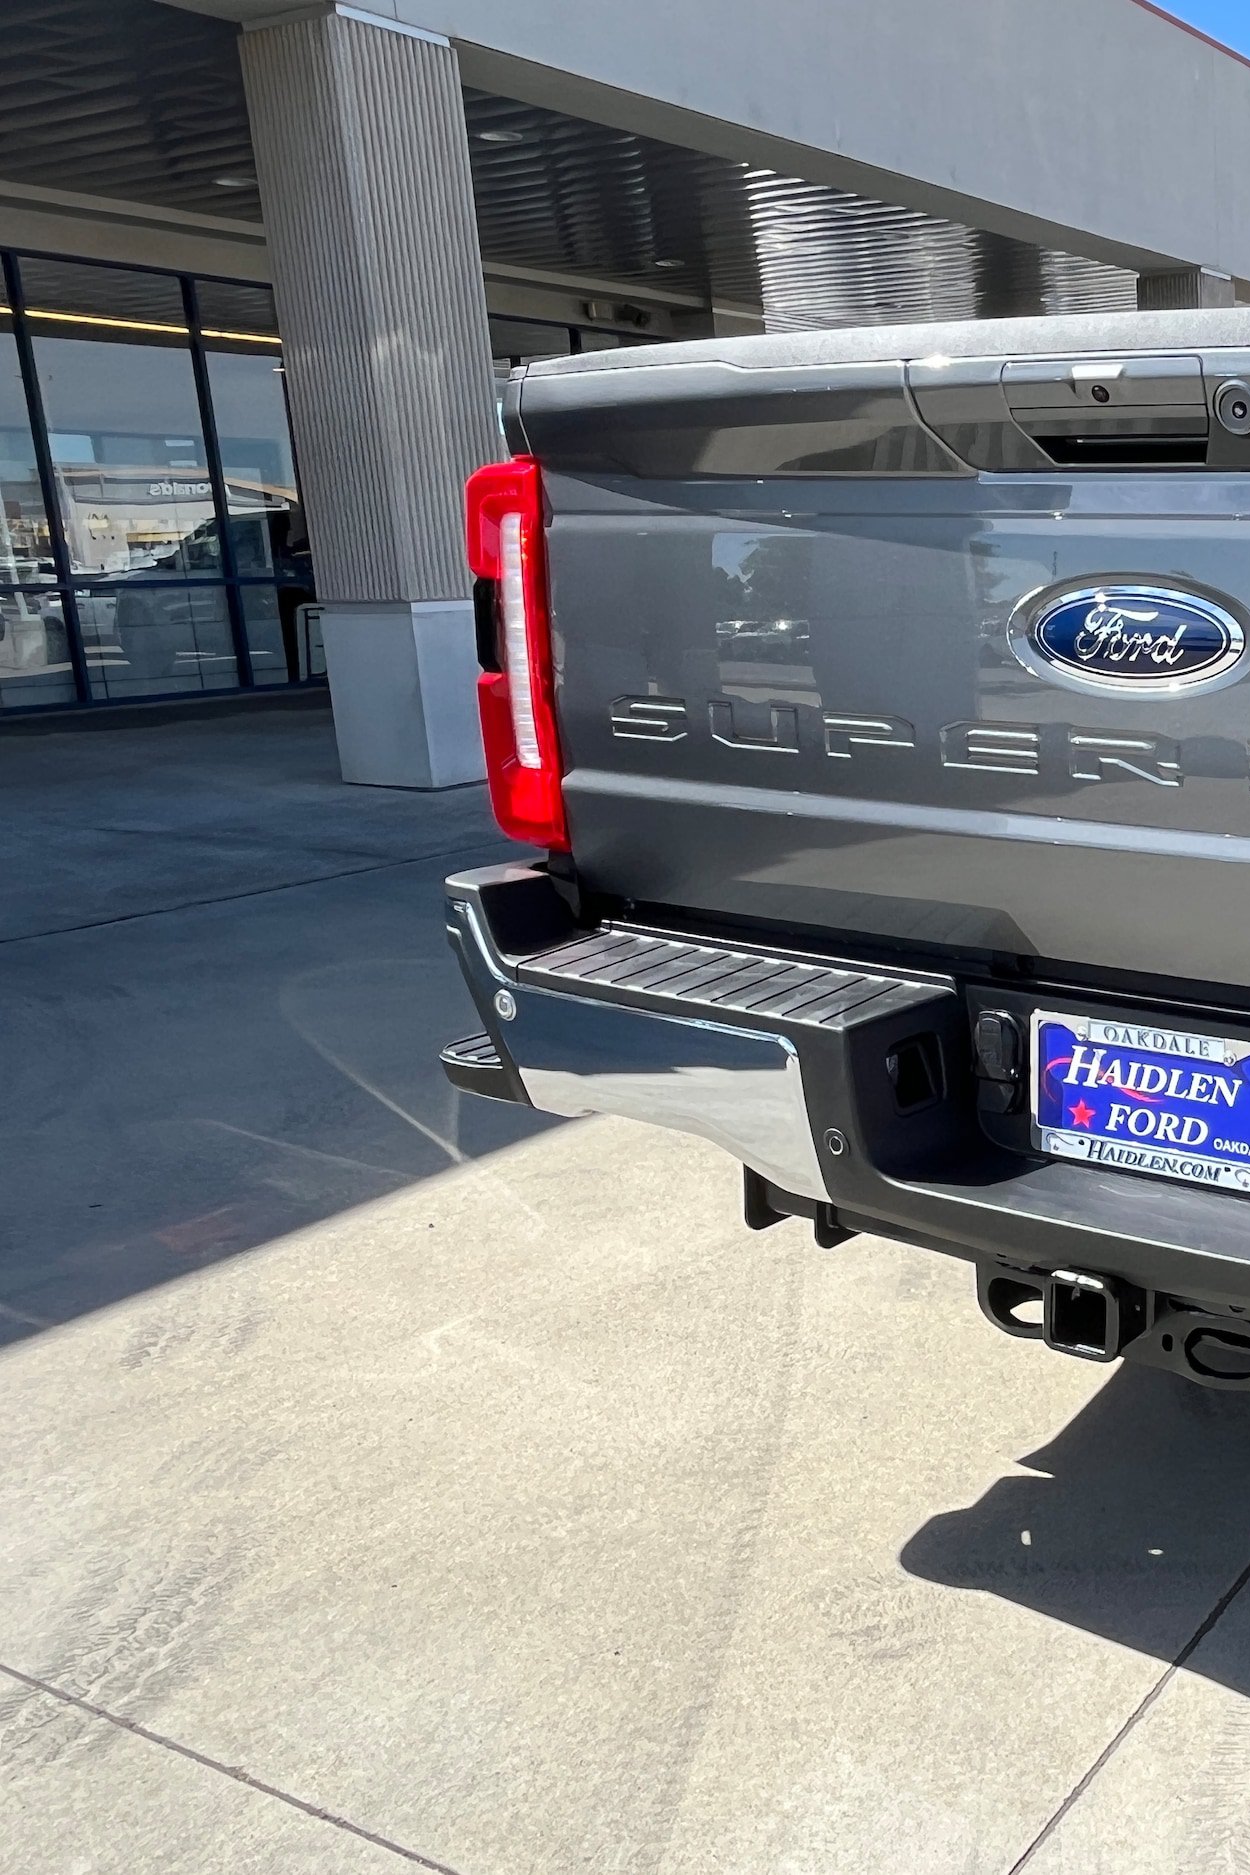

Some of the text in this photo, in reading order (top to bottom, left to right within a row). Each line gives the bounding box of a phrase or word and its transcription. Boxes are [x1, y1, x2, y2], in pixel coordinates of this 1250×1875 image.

[1074, 605, 1188, 665] Ford
[609, 695, 1184, 787] SUPER
[1103, 1025, 1210, 1058] OAKDALE
[1063, 1045, 1243, 1107] HAIDLEN
[1105, 1103, 1209, 1146] FORD
[1087, 1139, 1222, 1183] HAIDLEN.COM
